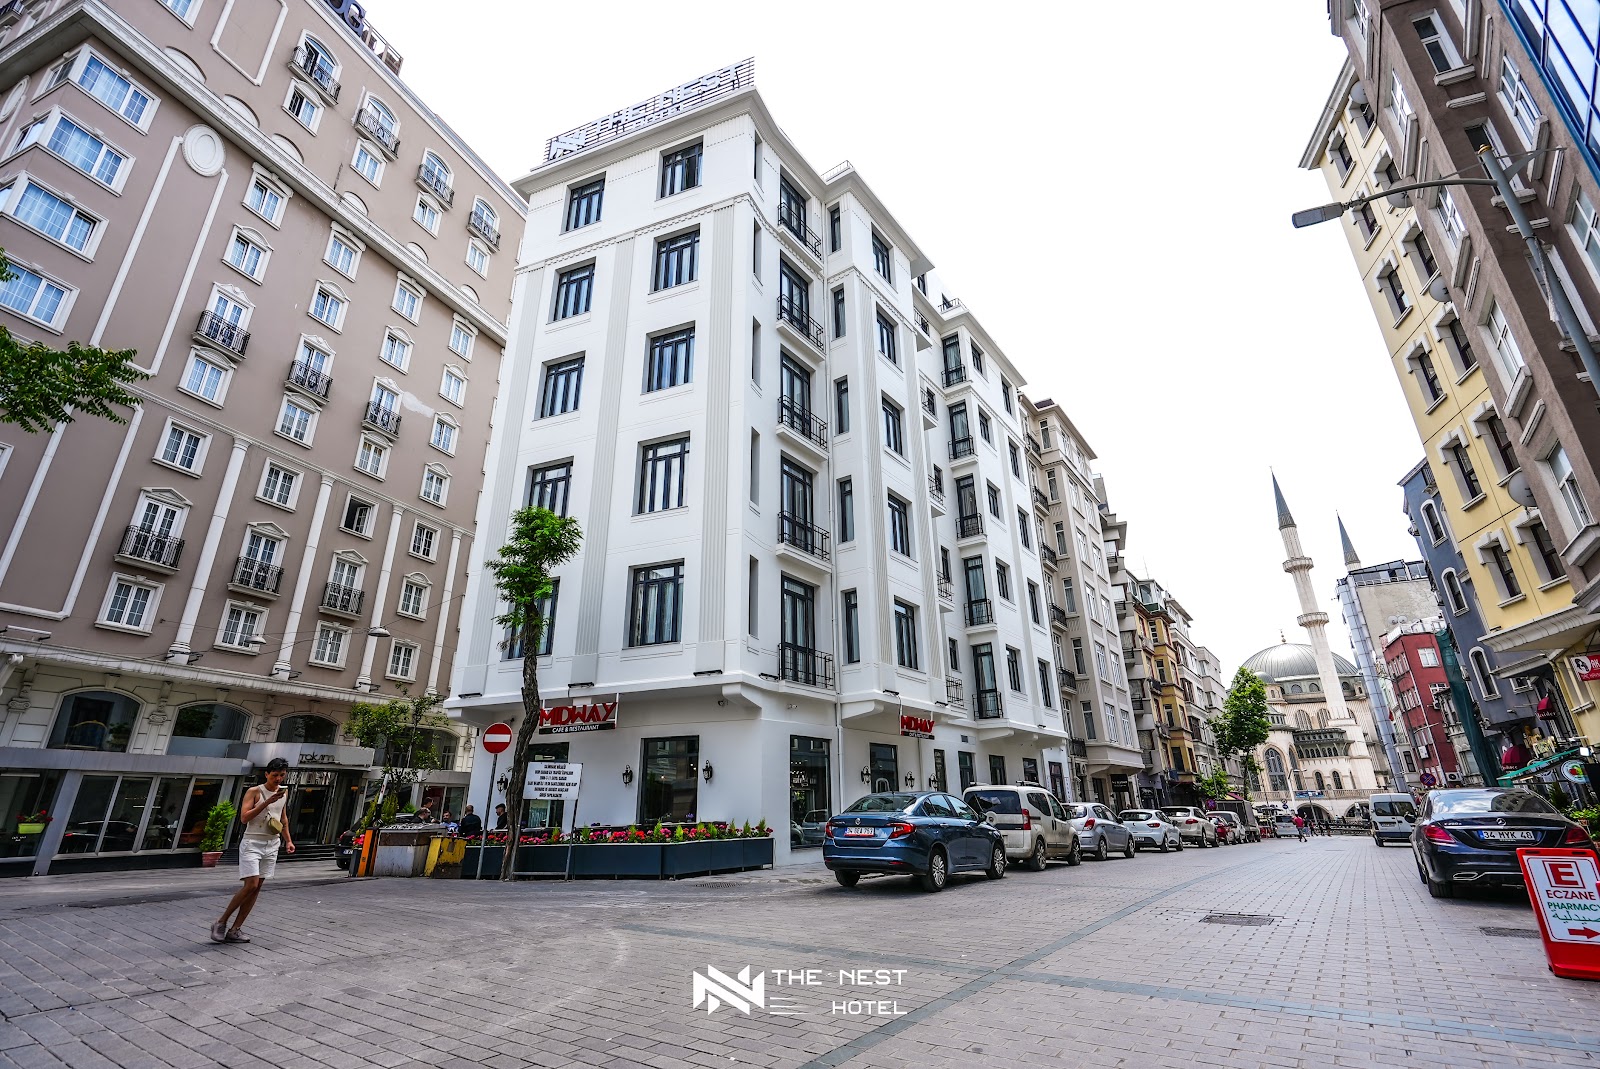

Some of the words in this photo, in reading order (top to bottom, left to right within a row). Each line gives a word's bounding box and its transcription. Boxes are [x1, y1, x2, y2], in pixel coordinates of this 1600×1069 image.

[591, 100, 648, 134] THE
[659, 61, 743, 109] NEST
[539, 702, 617, 727] MIDWAY
[901, 714, 935, 733] MIDWAY
[1484, 831, 1496, 839] 34
[1499, 831, 1517, 840] MYK
[1548, 863, 1579, 886] E
[1546, 889, 1596, 900] ECZANE
